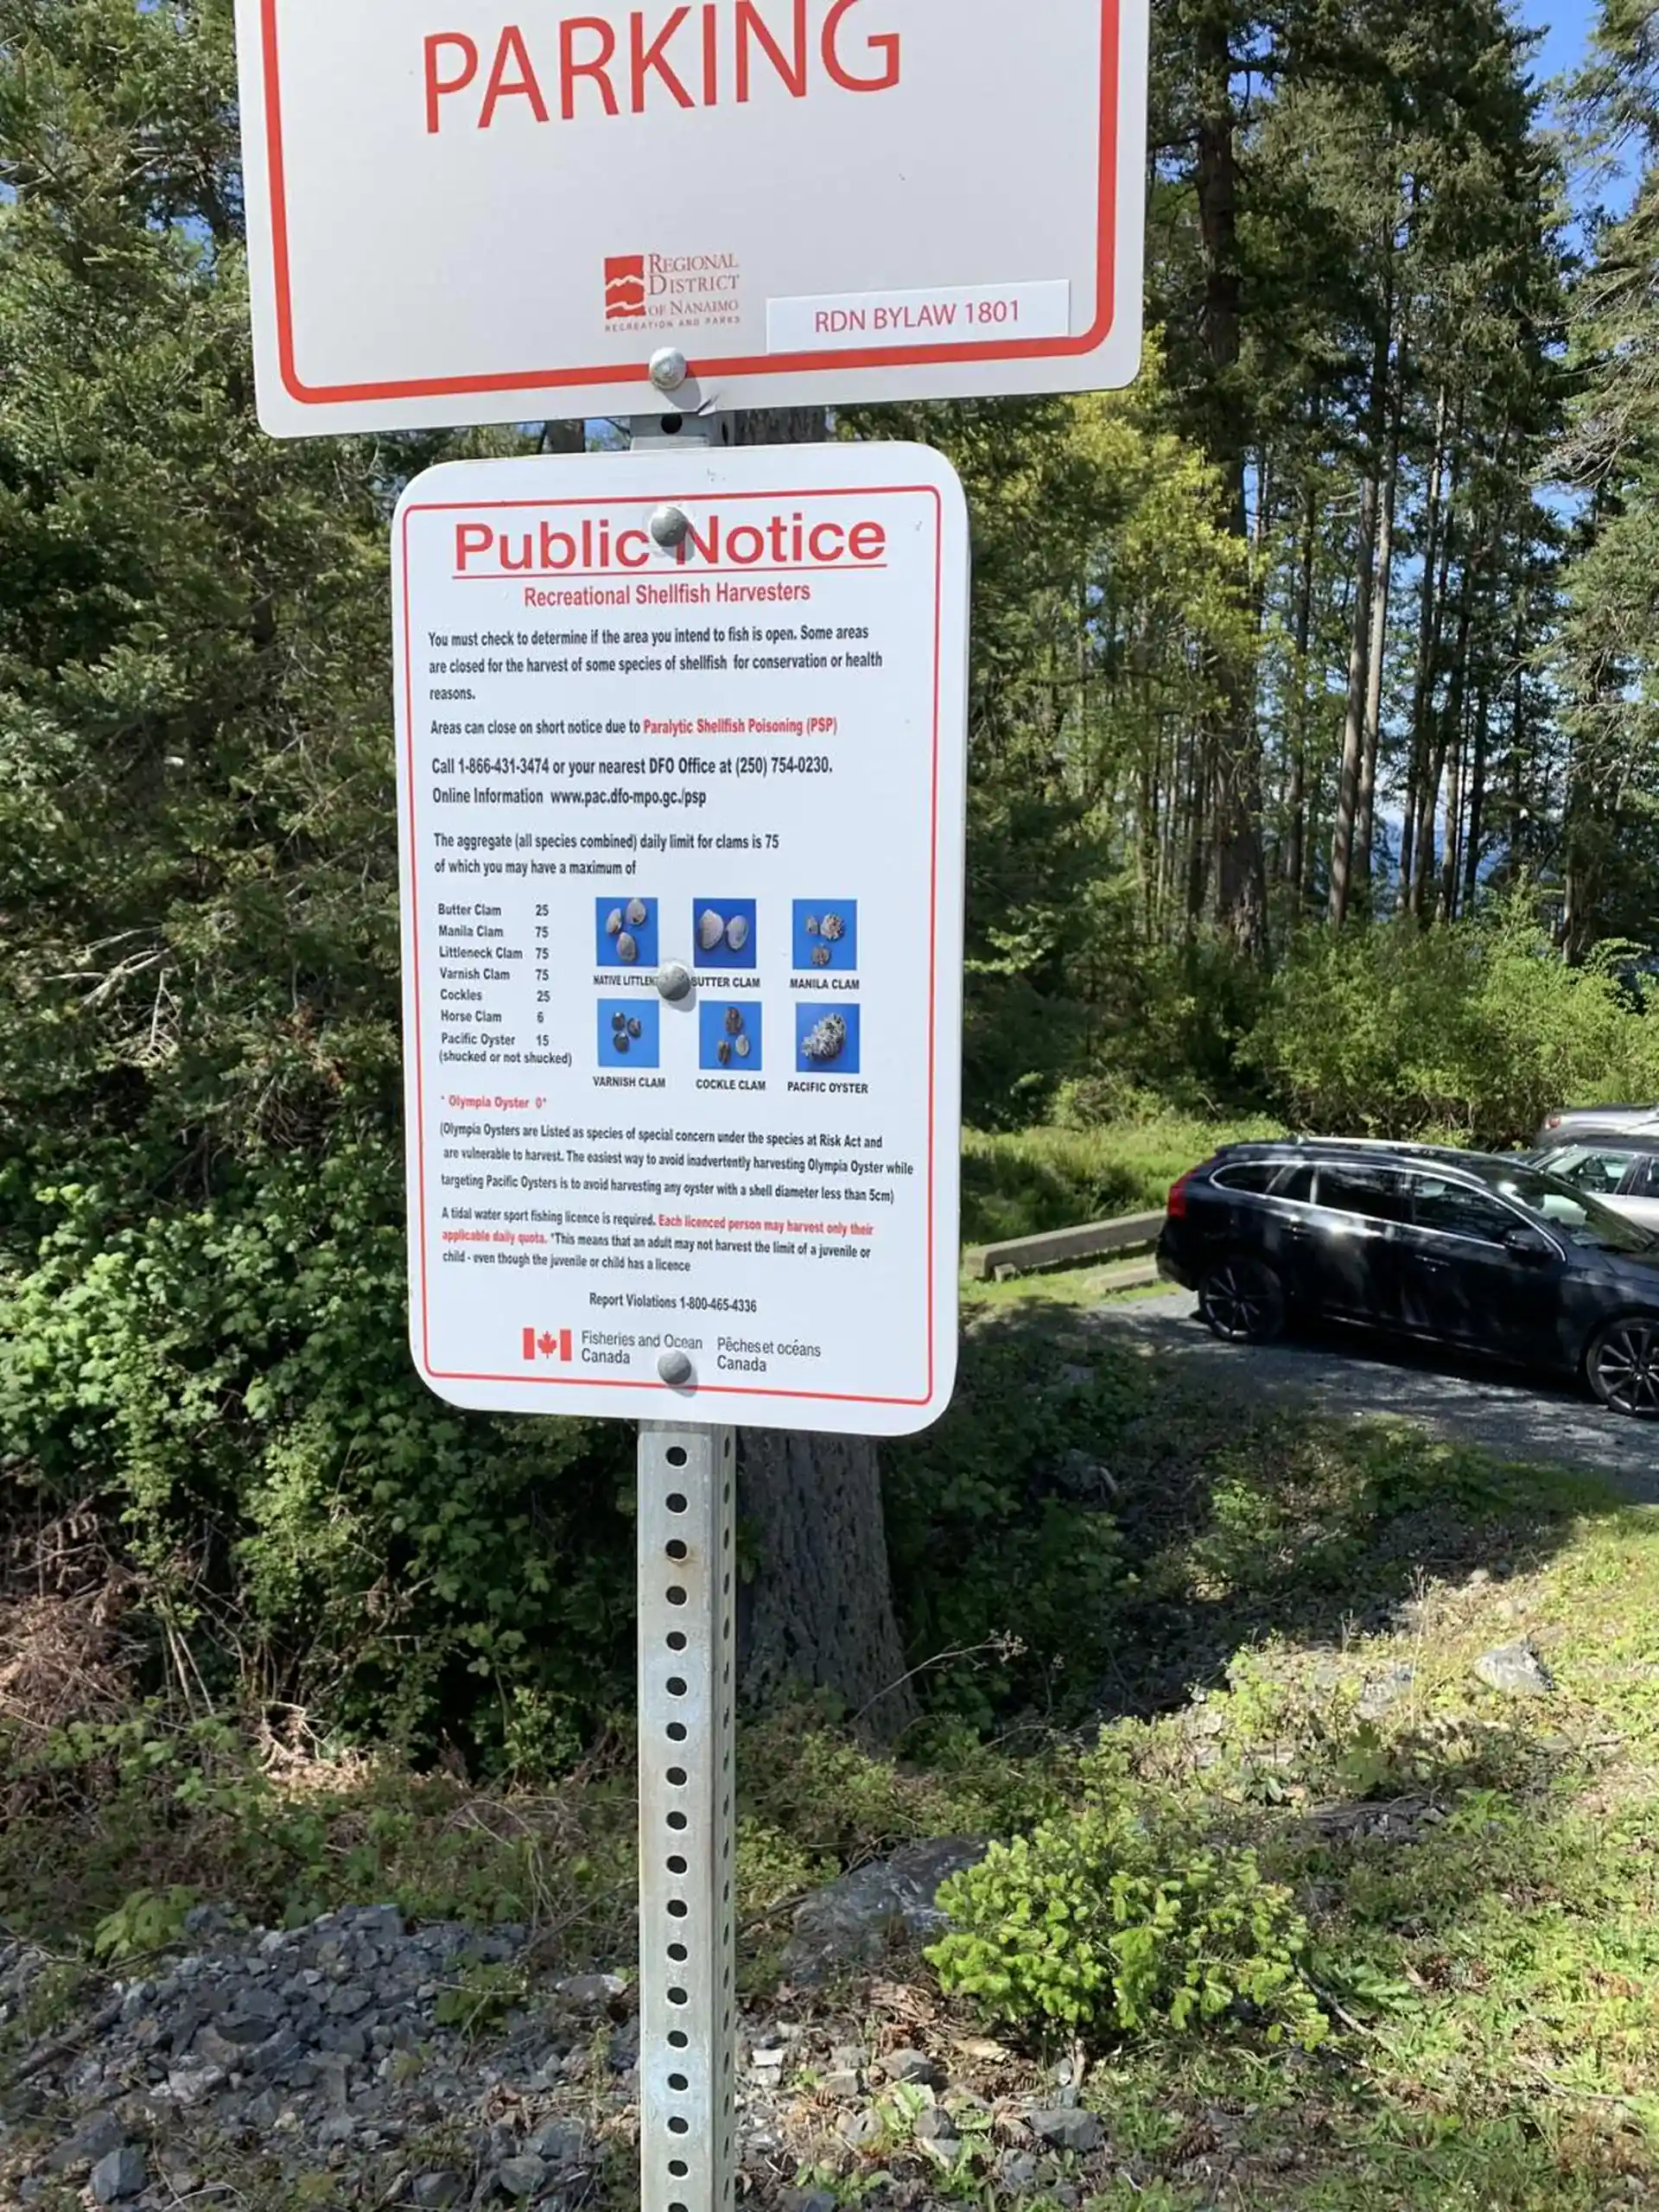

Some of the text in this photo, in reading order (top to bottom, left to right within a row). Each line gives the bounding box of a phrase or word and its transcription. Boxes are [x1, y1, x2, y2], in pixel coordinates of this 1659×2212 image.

[423, 0, 900, 133] PARKING
[605, 315, 741, 333] RECREATION AND PARKS
[815, 300, 1020, 333] RDN BYLAW 1801
[454, 512, 887, 571] Public Notice
[524, 582, 810, 607] Recreational Shellfish Harvesters
[428, 625, 868, 646] You must check to determine if the area you intend to fish is open. Some areas
[429, 652, 882, 674] are closed for the harvest of some species of shellfish for conservation or health
[429, 689, 475, 700] reasons.
[430, 717, 836, 737] Areas can close on short notice due to Paralytic Shellfish Poisoning (PSP)
[431, 756, 832, 778] Call 1-866-431-3474 or your nearest DFO Office at (250) 754-0230.
[432, 787, 706, 807] Online Information www.pac.dfo-mpo.gc./psp
[433, 832, 779, 852] The aggregate (all species combined) daily limit for clams is 75
[434, 858, 636, 877] of which you may have a maximum of
[437, 903, 549, 917] Butter Clam 25
[438, 925, 549, 938] Manila Clam 75
[438, 945, 549, 960] Littleneck Clam 75
[439, 967, 549, 981] Varnish Clam 75
[593, 975, 621, 985] NATIVE
[691, 976, 760, 988] BUTTER CLAM
[789, 978, 859, 989] MANILA CLAM
[440, 988, 550, 1002] Cockles 25
[440, 1009, 543, 1023] Horse Clam 6
[441, 1032, 549, 1048] Pacific Oyster 15
[438, 1050, 572, 1066] (shucked or not shucked)
[592, 1076, 665, 1088] VARNISH CLAM
[696, 1078, 766, 1090] COCKLE CLAM
[787, 1081, 868, 1094] PACIFIC OYSTER
[448, 1095, 529, 1111] Olympia Oyster
[819, 1133, 841, 1147] Risk
[753, 1156, 913, 1176] harvesting Olympia Oyster while
[748, 1184, 867, 1201] shell diameter less than
[474, 1208, 529, 1224] water sport
[817, 1243, 857, 1258] juvenile
[589, 1292, 757, 1313] Report Violations 1-800-465-4336
[582, 1330, 702, 1349] Fisheries and Ocean
[776, 1338, 821, 1357] océans
[581, 1347, 630, 1364] Canada
[716, 1354, 766, 1371] Canada
